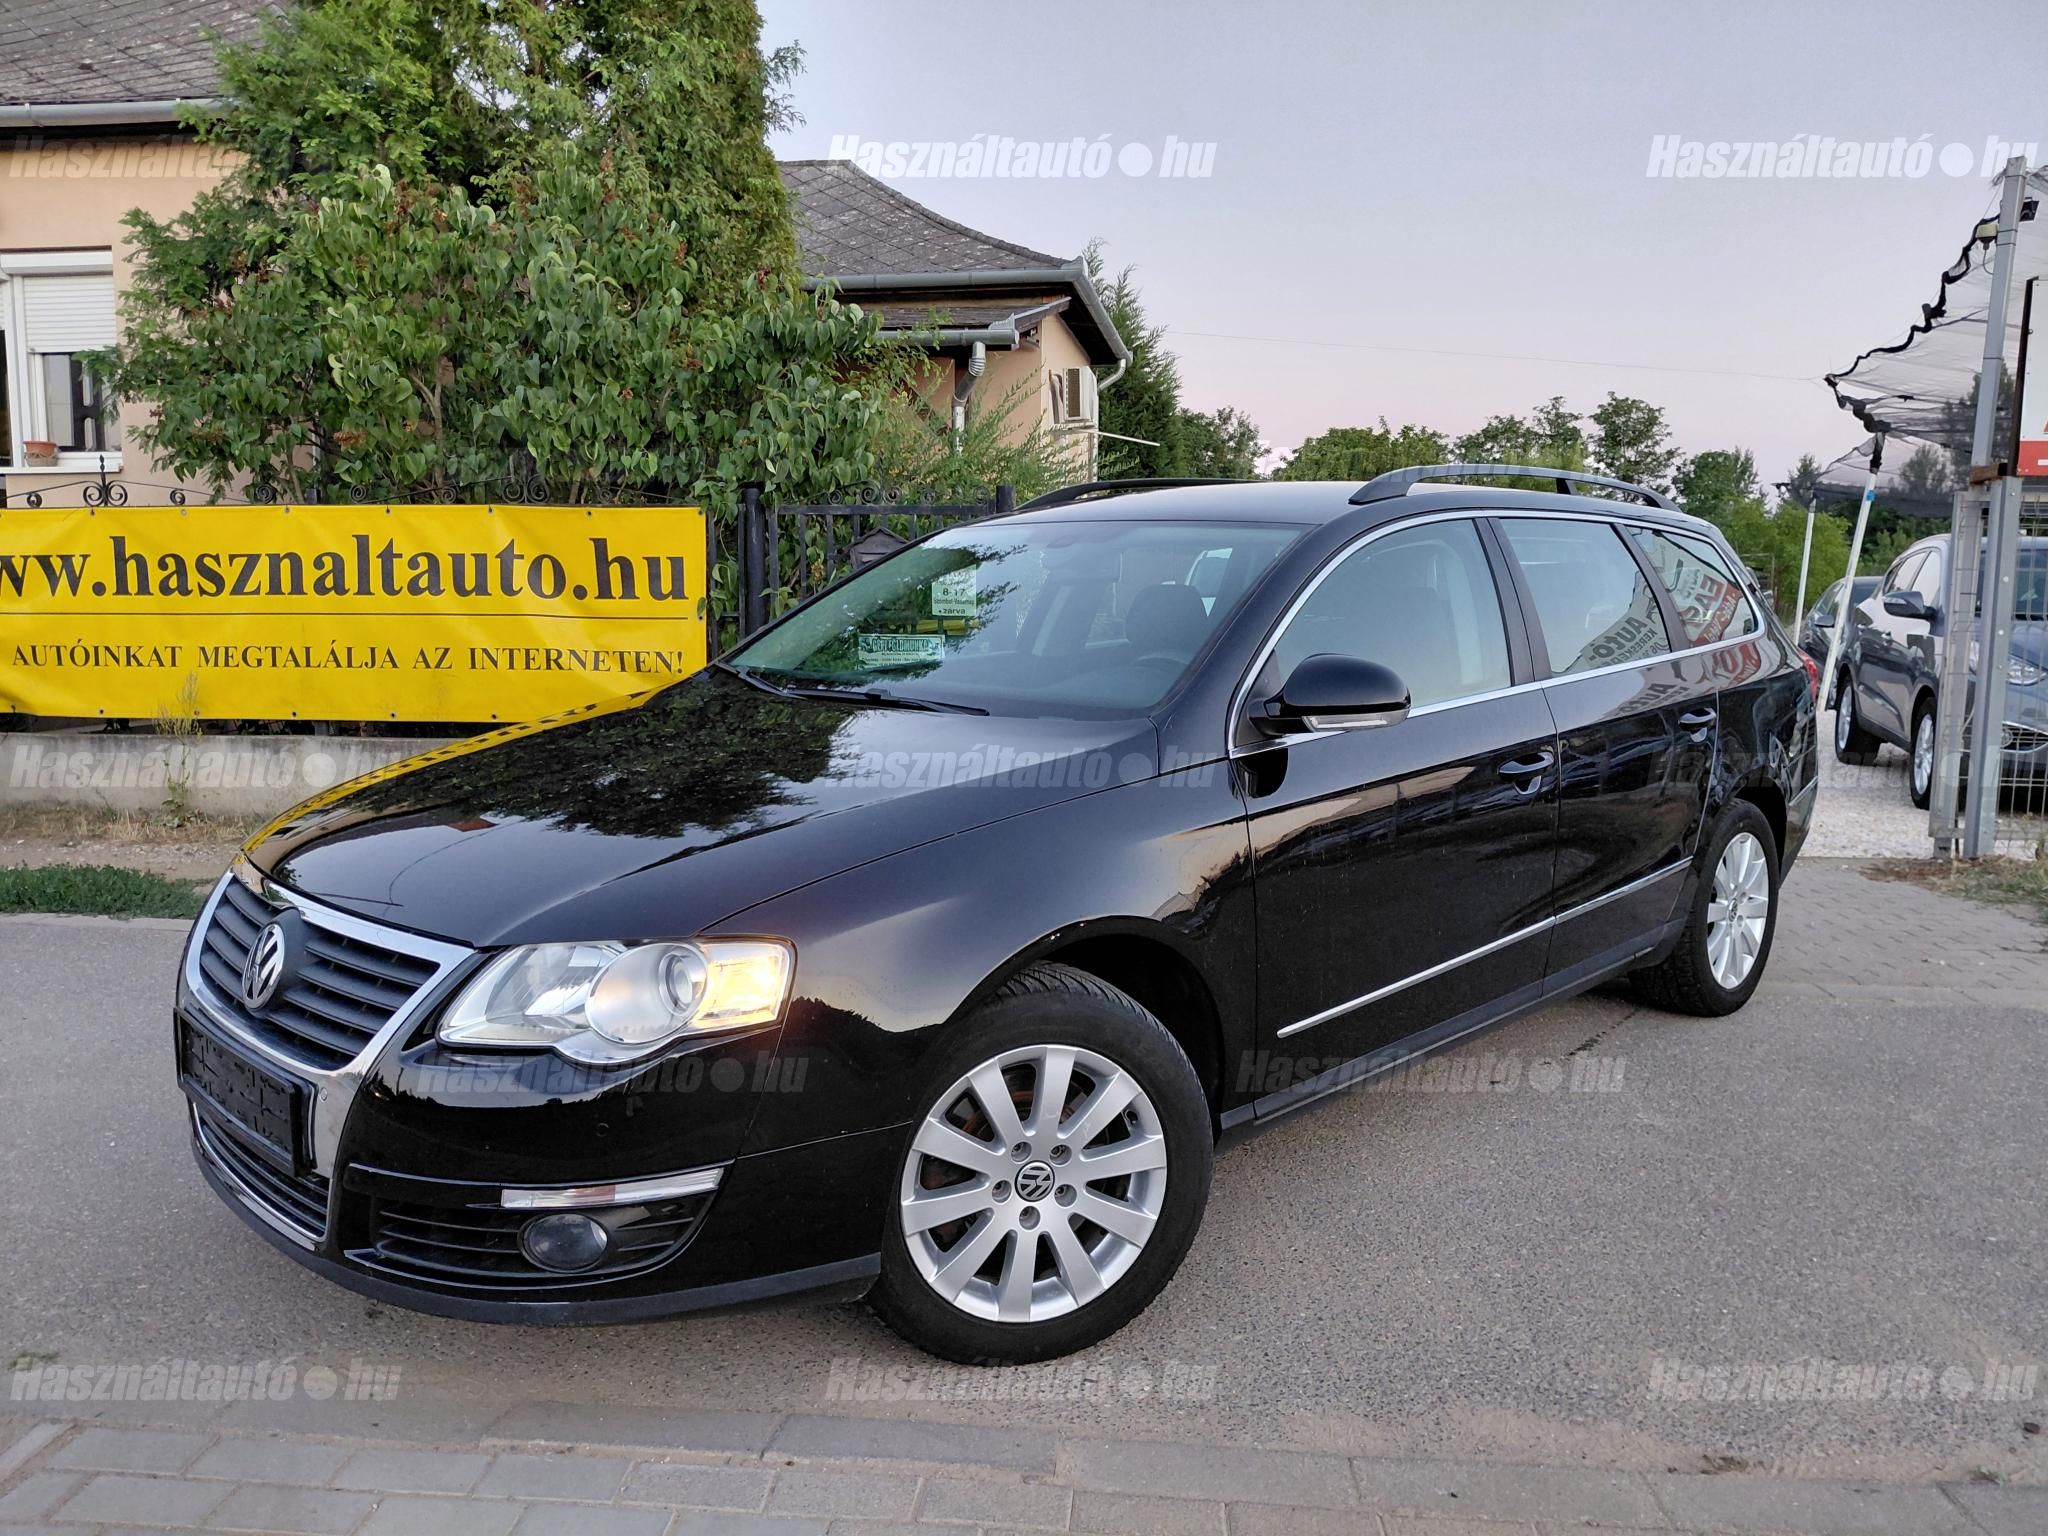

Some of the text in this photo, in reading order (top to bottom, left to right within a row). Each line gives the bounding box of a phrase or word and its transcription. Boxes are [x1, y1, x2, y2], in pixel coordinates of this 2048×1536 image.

[12, 638, 684, 674] AUTÓINKAT MEGTALÁLJA AZ INTERNETEN!
